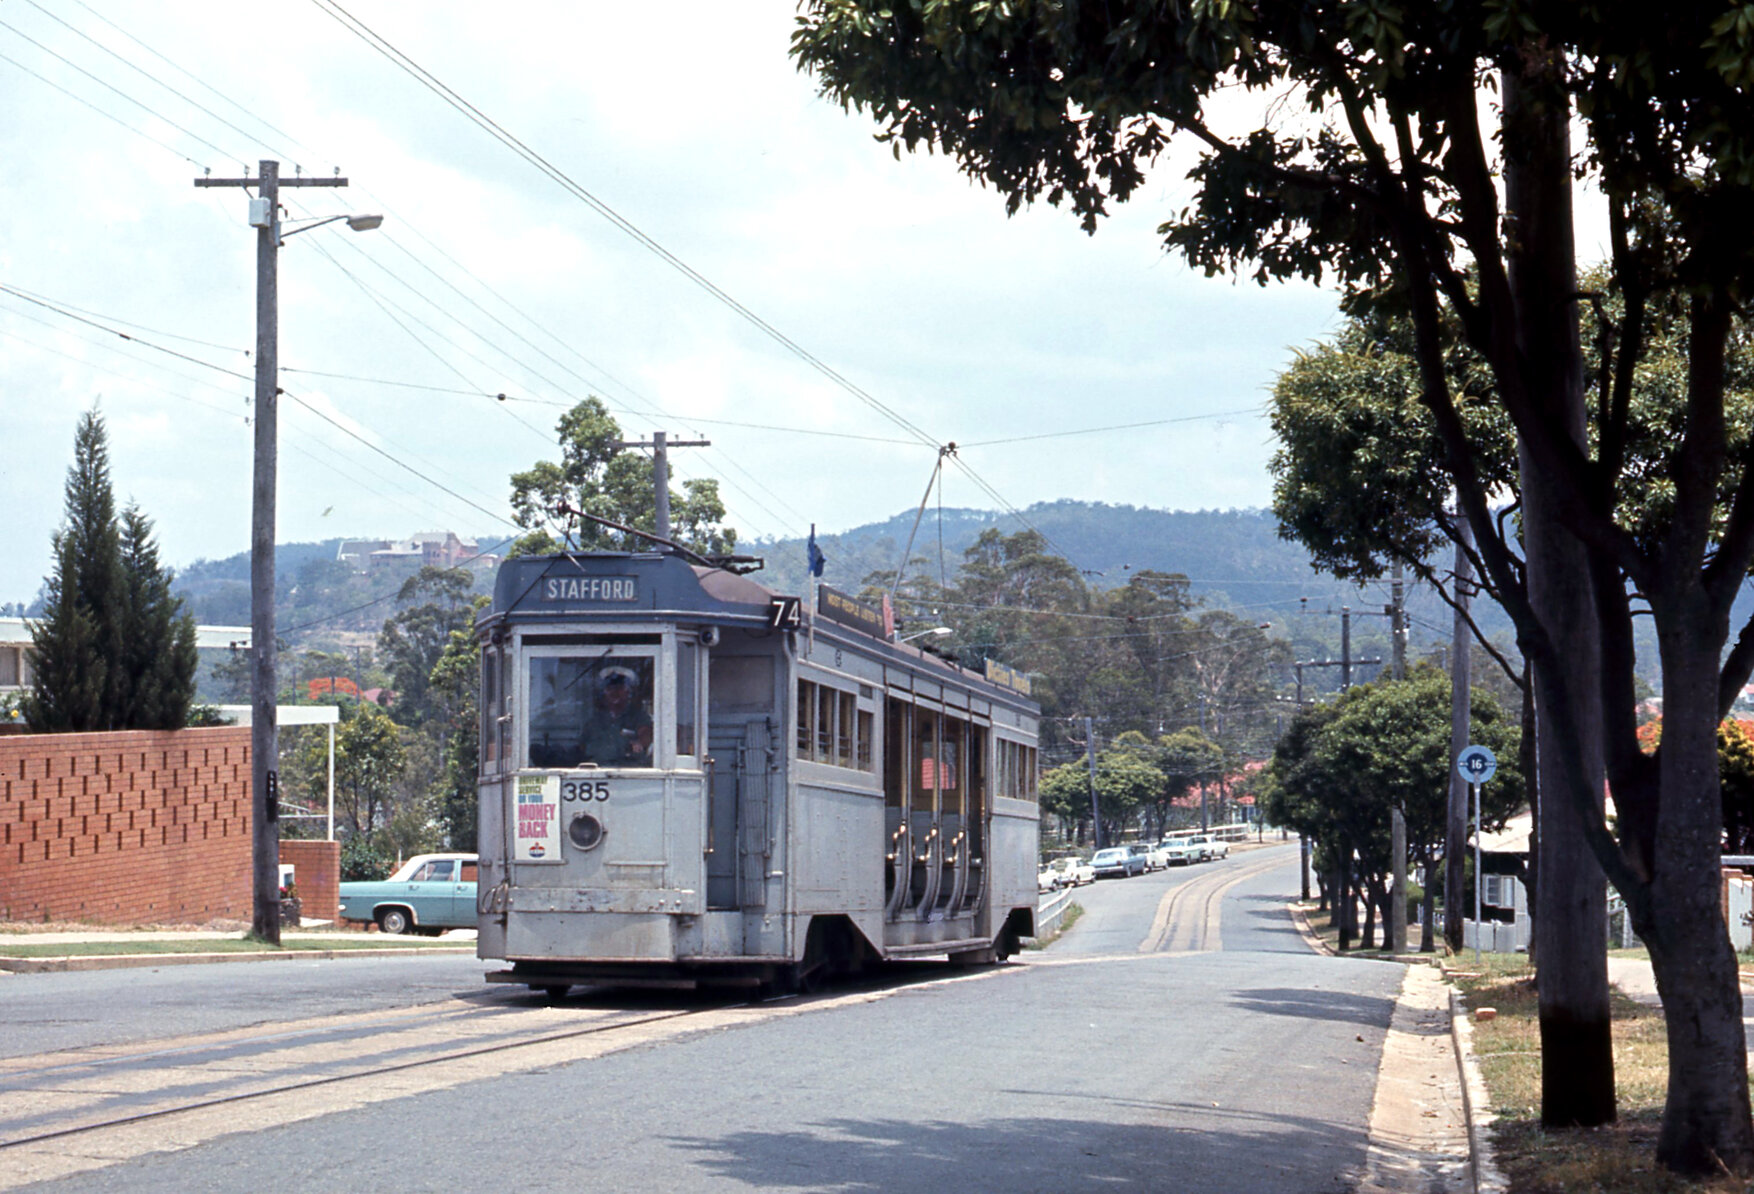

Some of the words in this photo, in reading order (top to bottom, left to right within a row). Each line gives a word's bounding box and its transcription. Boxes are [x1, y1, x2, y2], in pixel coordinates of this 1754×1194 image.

[547, 578, 635, 600] STAFFORD
[772, 600, 801, 627] 74
[1471, 759, 1483, 770] 16
[563, 782, 610, 802] 385
[518, 804, 556, 821] MONEY
[518, 821, 548, 838] BACK
